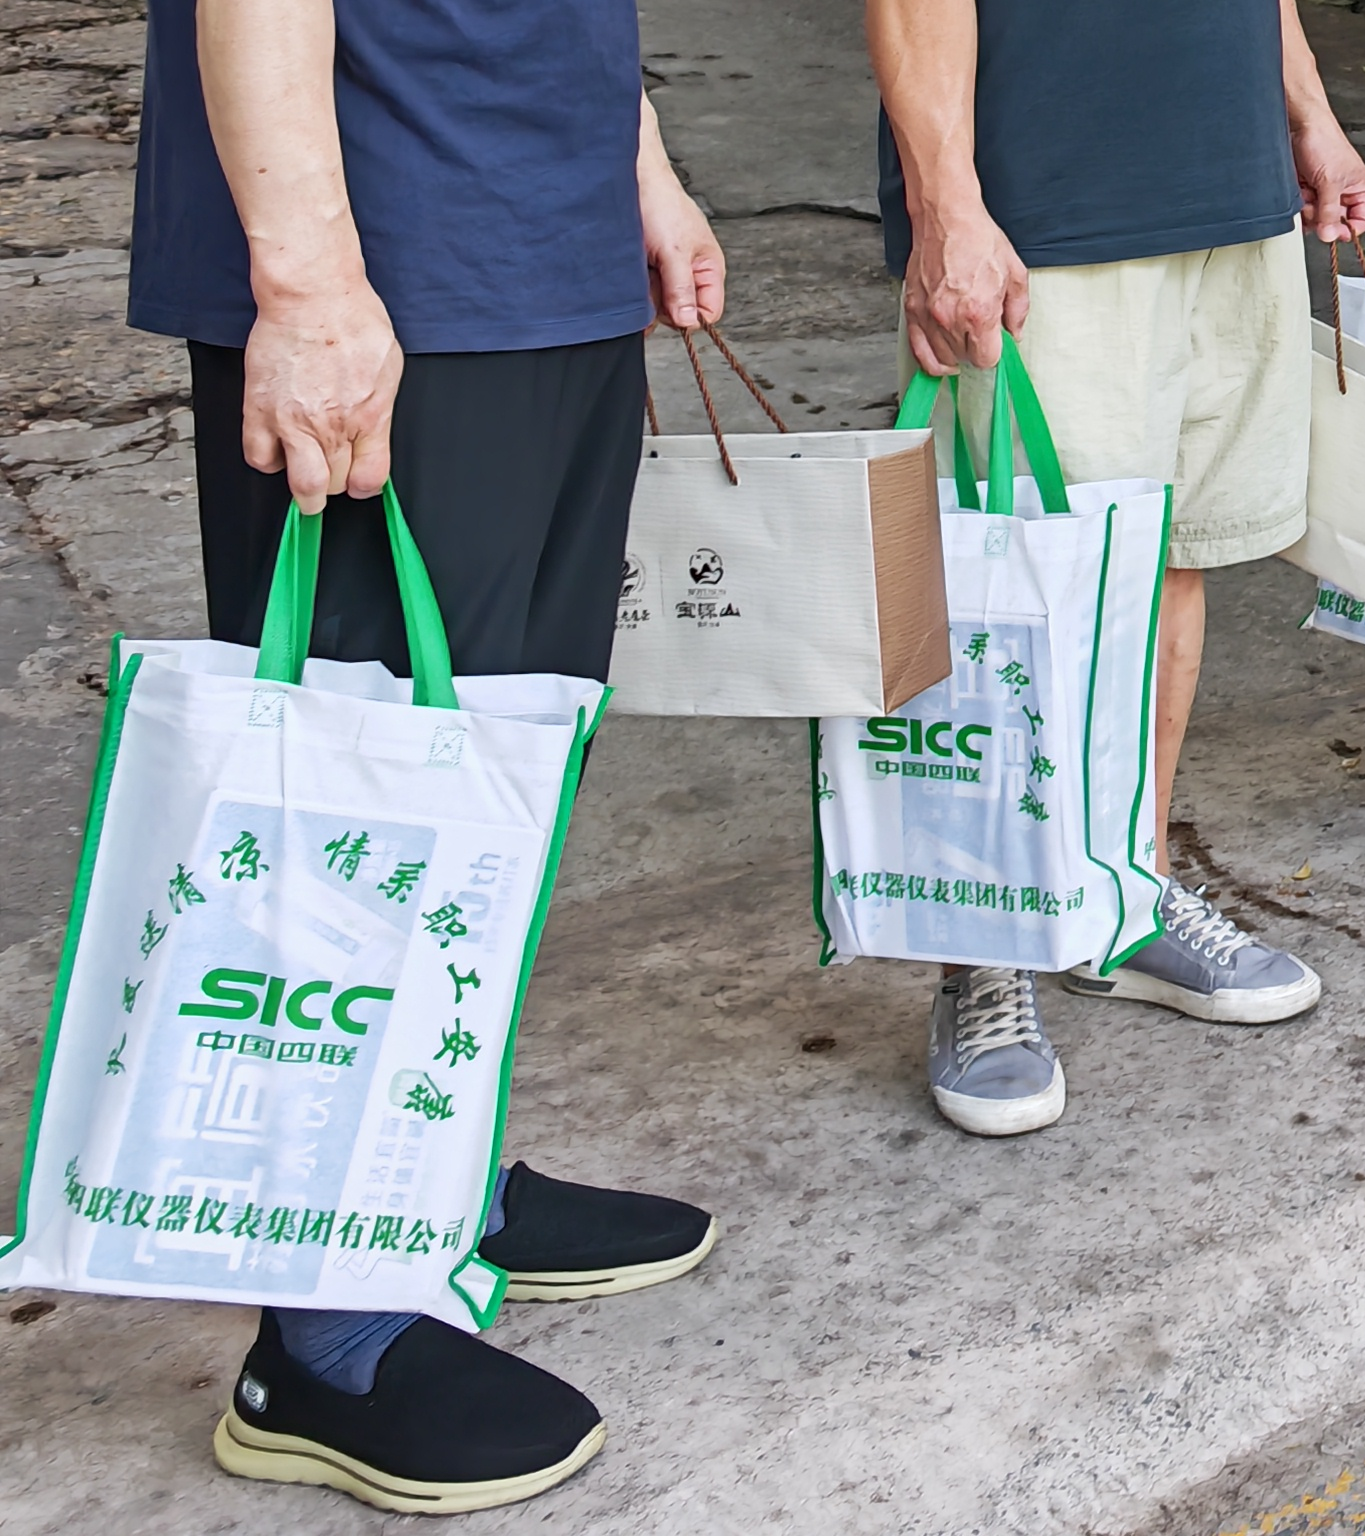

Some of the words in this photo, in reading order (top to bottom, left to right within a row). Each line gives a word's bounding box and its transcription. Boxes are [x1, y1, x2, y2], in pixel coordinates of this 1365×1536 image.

[858, 716, 993, 762] SICC
[875, 759, 982, 784] 中国四联
[178, 967, 395, 1036] SICC
[196, 1029, 359, 1068] 中国四联
